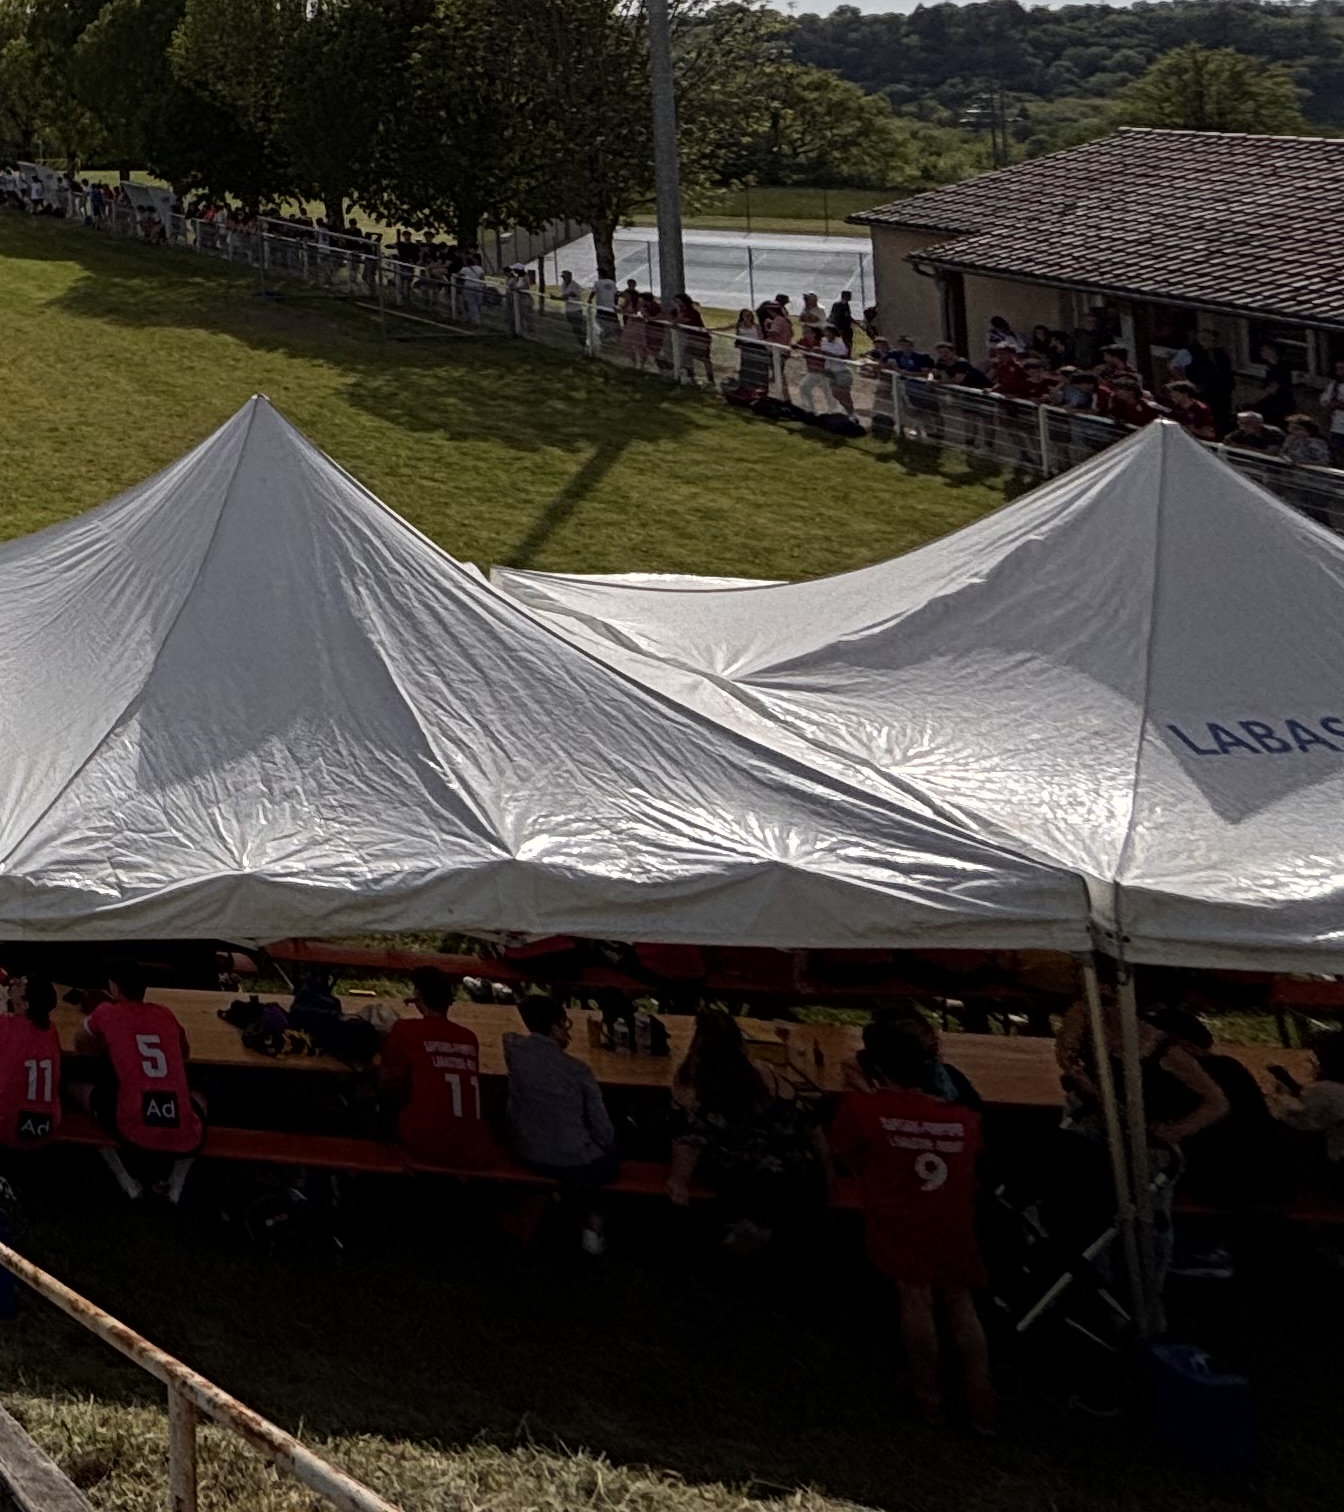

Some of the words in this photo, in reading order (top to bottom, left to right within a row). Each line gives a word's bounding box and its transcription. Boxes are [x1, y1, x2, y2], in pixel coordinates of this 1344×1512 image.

[135, 1034, 168, 1078] 5
[24, 1059, 52, 1102] 11
[444, 1072, 481, 1120] 11
[146, 1098, 175, 1118] Ad
[914, 1152, 948, 1191] 9
